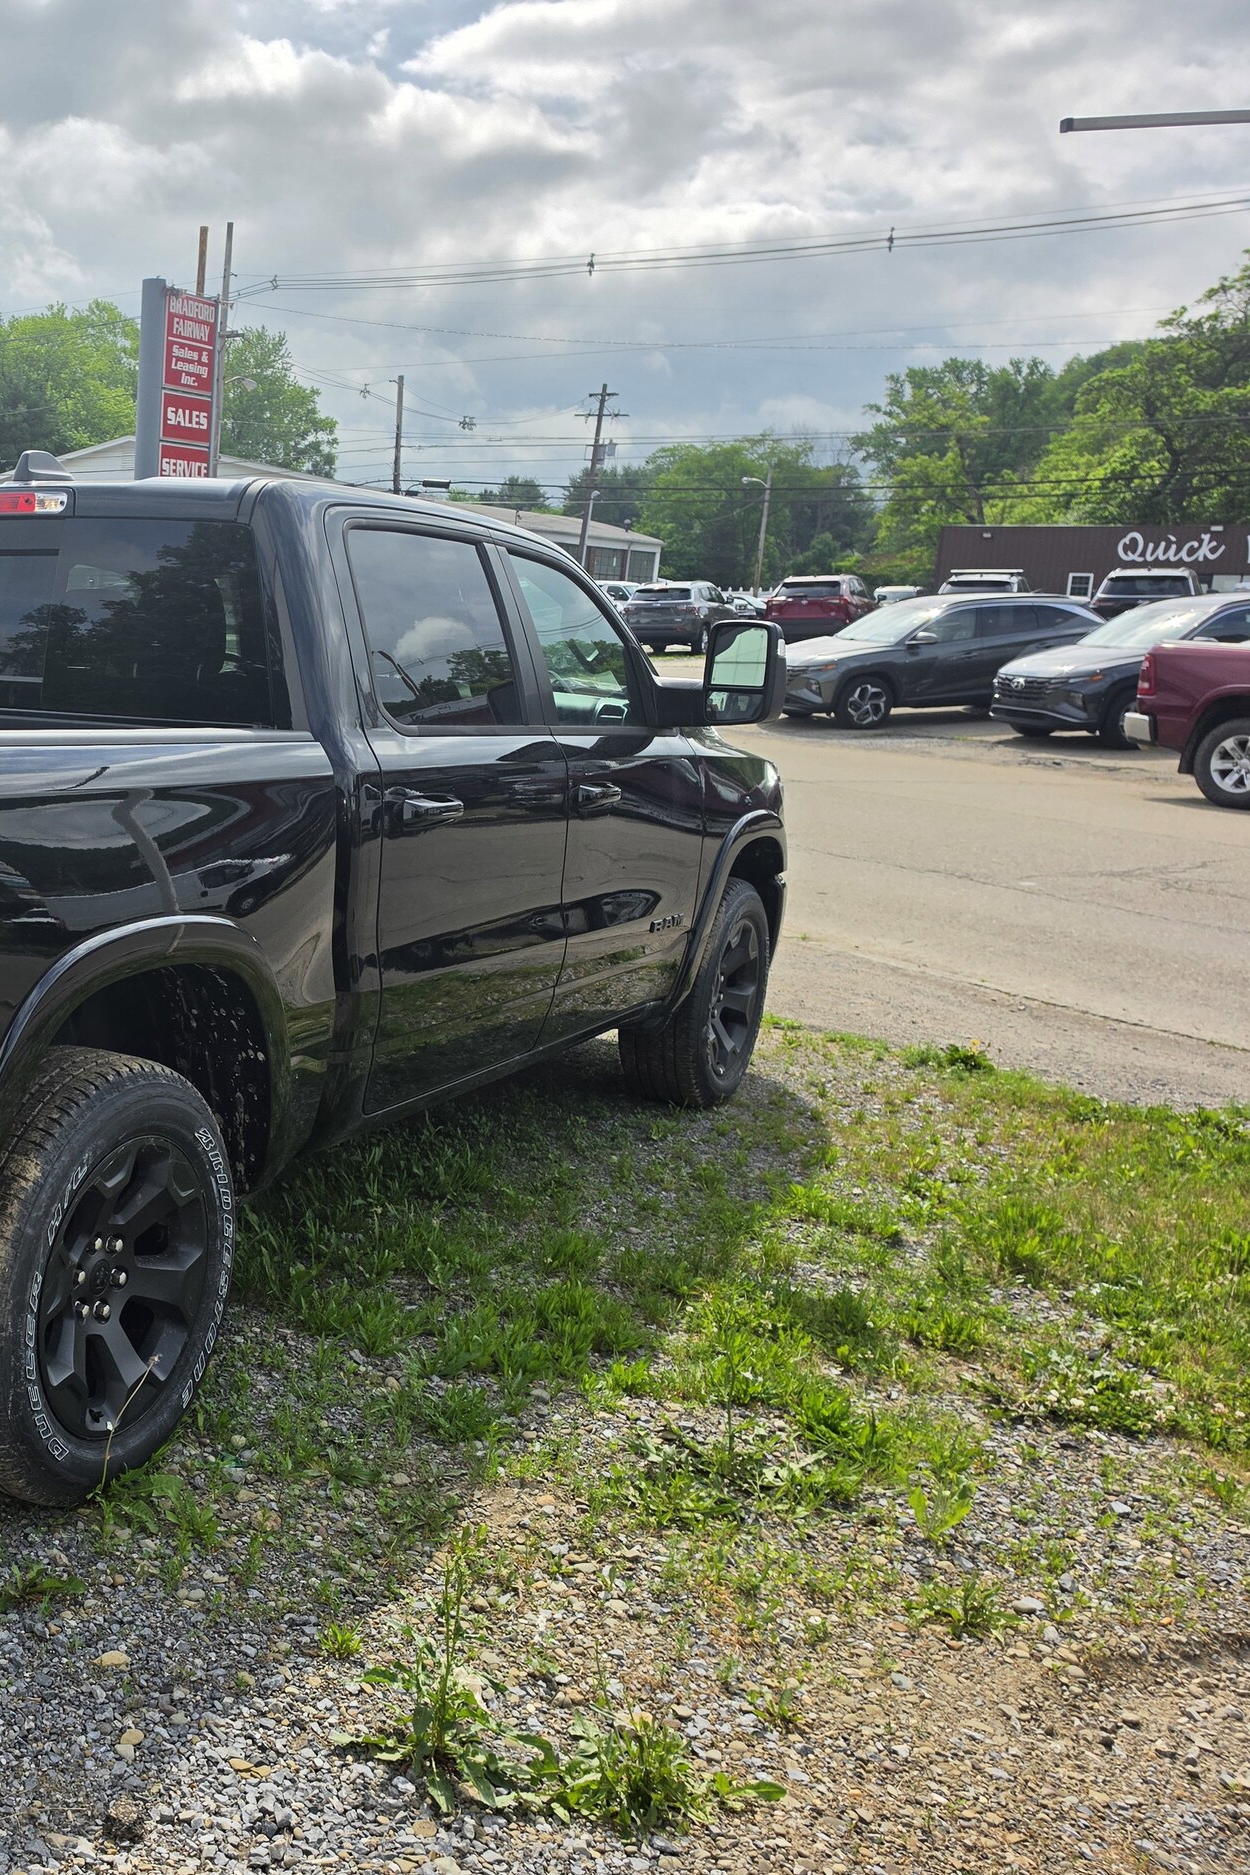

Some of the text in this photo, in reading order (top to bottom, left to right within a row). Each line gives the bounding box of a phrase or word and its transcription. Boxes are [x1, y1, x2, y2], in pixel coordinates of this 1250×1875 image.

[170, 295, 215, 323] BRADFORD
[173, 317, 210, 342] FAIRWAY
[172, 345, 209, 363] Sales &
[171, 358, 208, 378] Leasing
[180, 372, 198, 386] Inc.
[166, 406, 208, 430] SALES
[161, 457, 208, 478] SERVICE
[1117, 531, 1226, 562] Quick
[649, 913, 685, 934] RAM
[181, 1127, 233, 1409] BRIDGESTONE
[25, 1271, 70, 1461] DUELER
